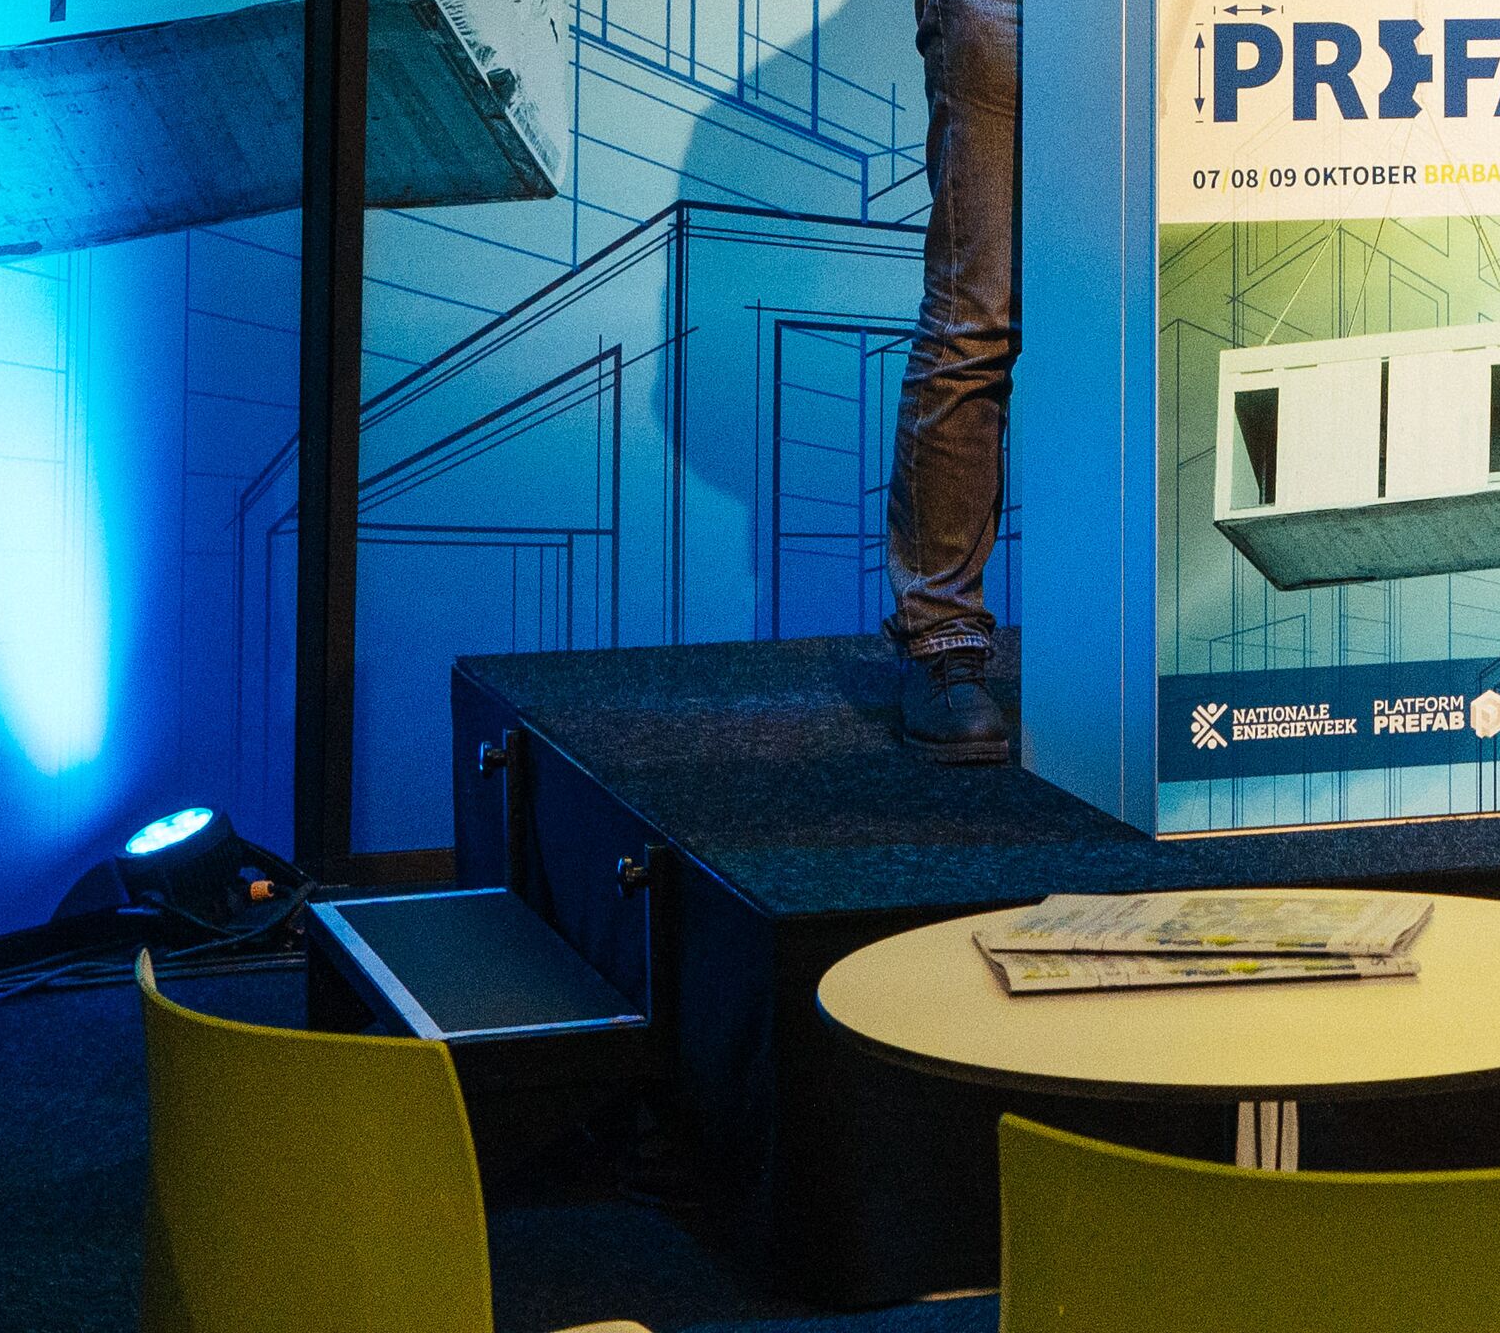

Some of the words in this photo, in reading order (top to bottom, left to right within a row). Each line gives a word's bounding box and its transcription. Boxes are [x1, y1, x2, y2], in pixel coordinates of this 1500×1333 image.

[1304, 165, 1417, 187] OKTOBER
[1233, 704, 1329, 724] NATIONALE
[1373, 696, 1464, 715] PLATFORM
[1233, 718, 1357, 741] ENERGIEWEEK
[1374, 711, 1465, 734] PREFAB
